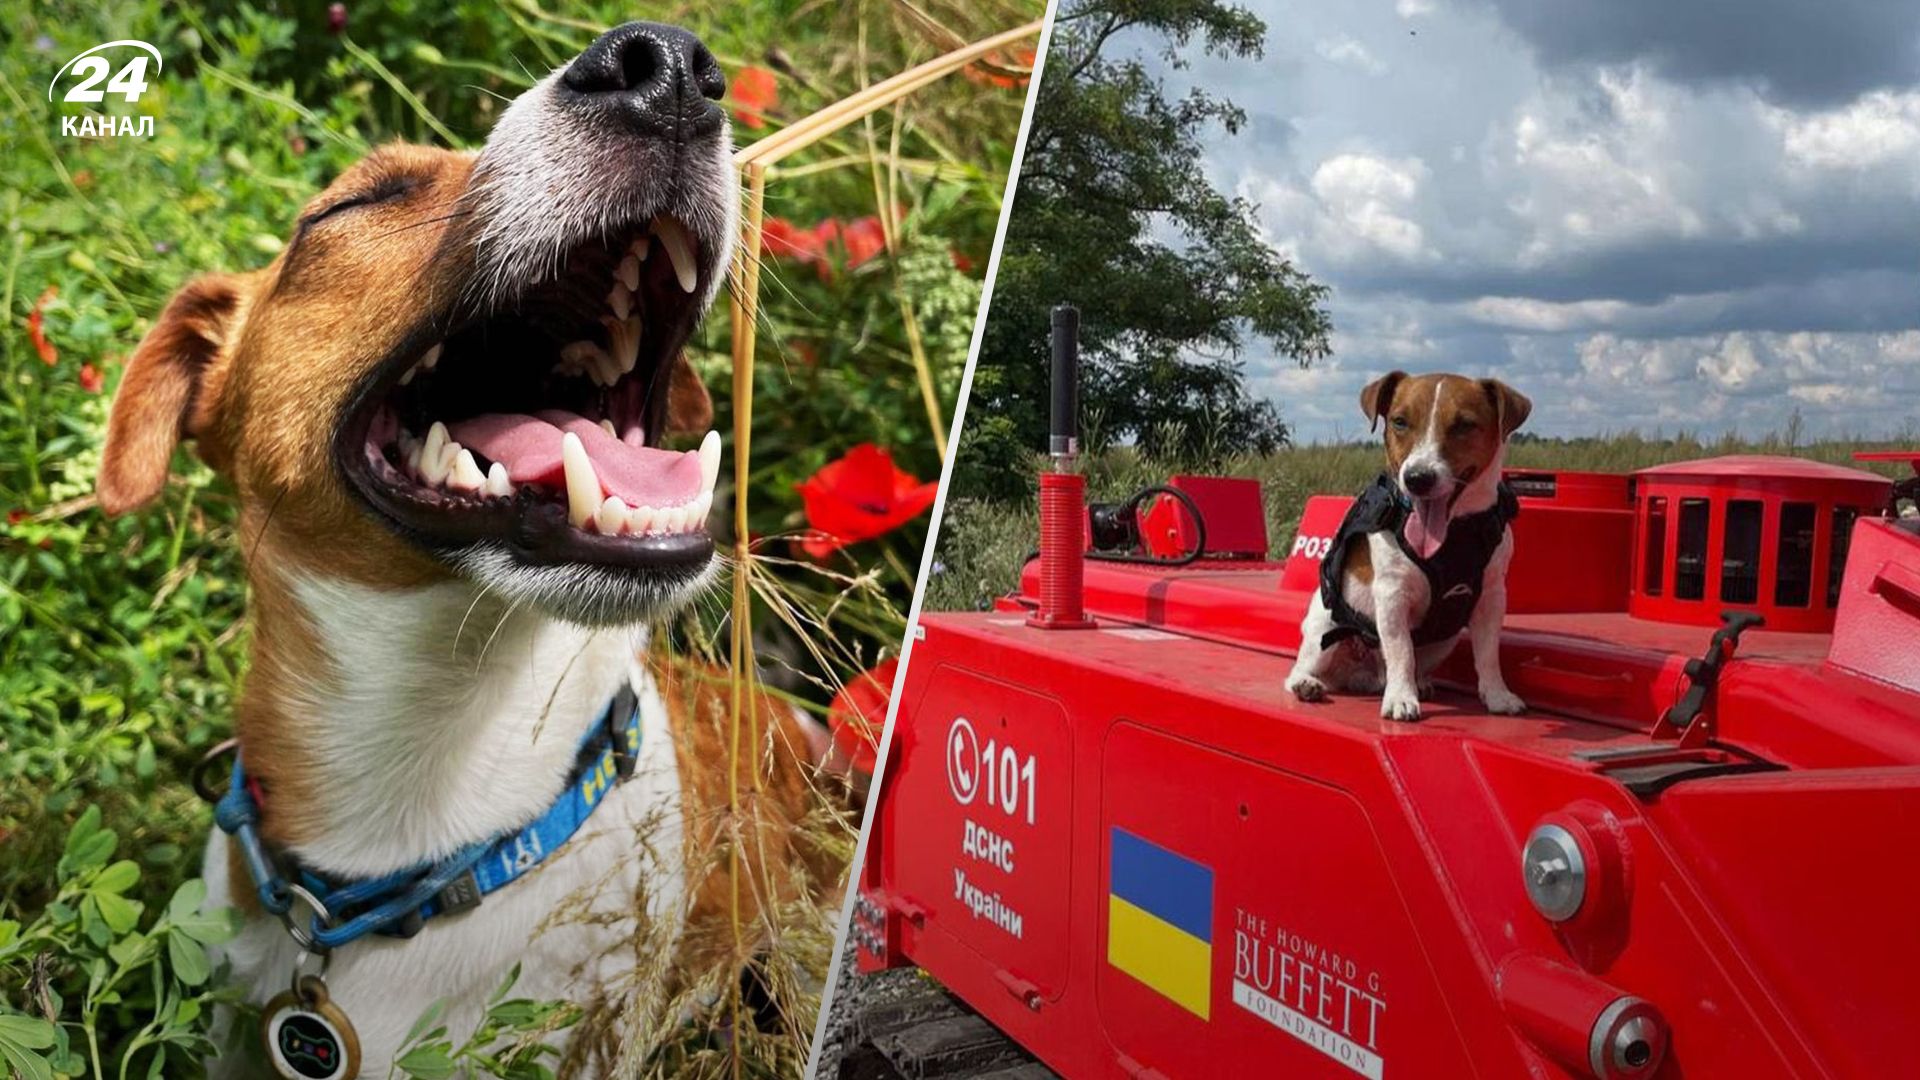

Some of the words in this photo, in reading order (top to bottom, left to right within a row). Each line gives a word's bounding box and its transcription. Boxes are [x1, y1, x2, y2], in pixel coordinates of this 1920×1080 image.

[982, 738, 1036, 825] 101
[963, 818, 1014, 874] ДСНС
[954, 867, 1023, 939] України
[1235, 929, 1387, 1050] BUFFETT
[1236, 908, 1266, 937] THE
[1277, 927, 1357, 981] HOWARD
[1368, 972, 1387, 996] G.
[1247, 991, 1367, 1070] FOUNDATION
